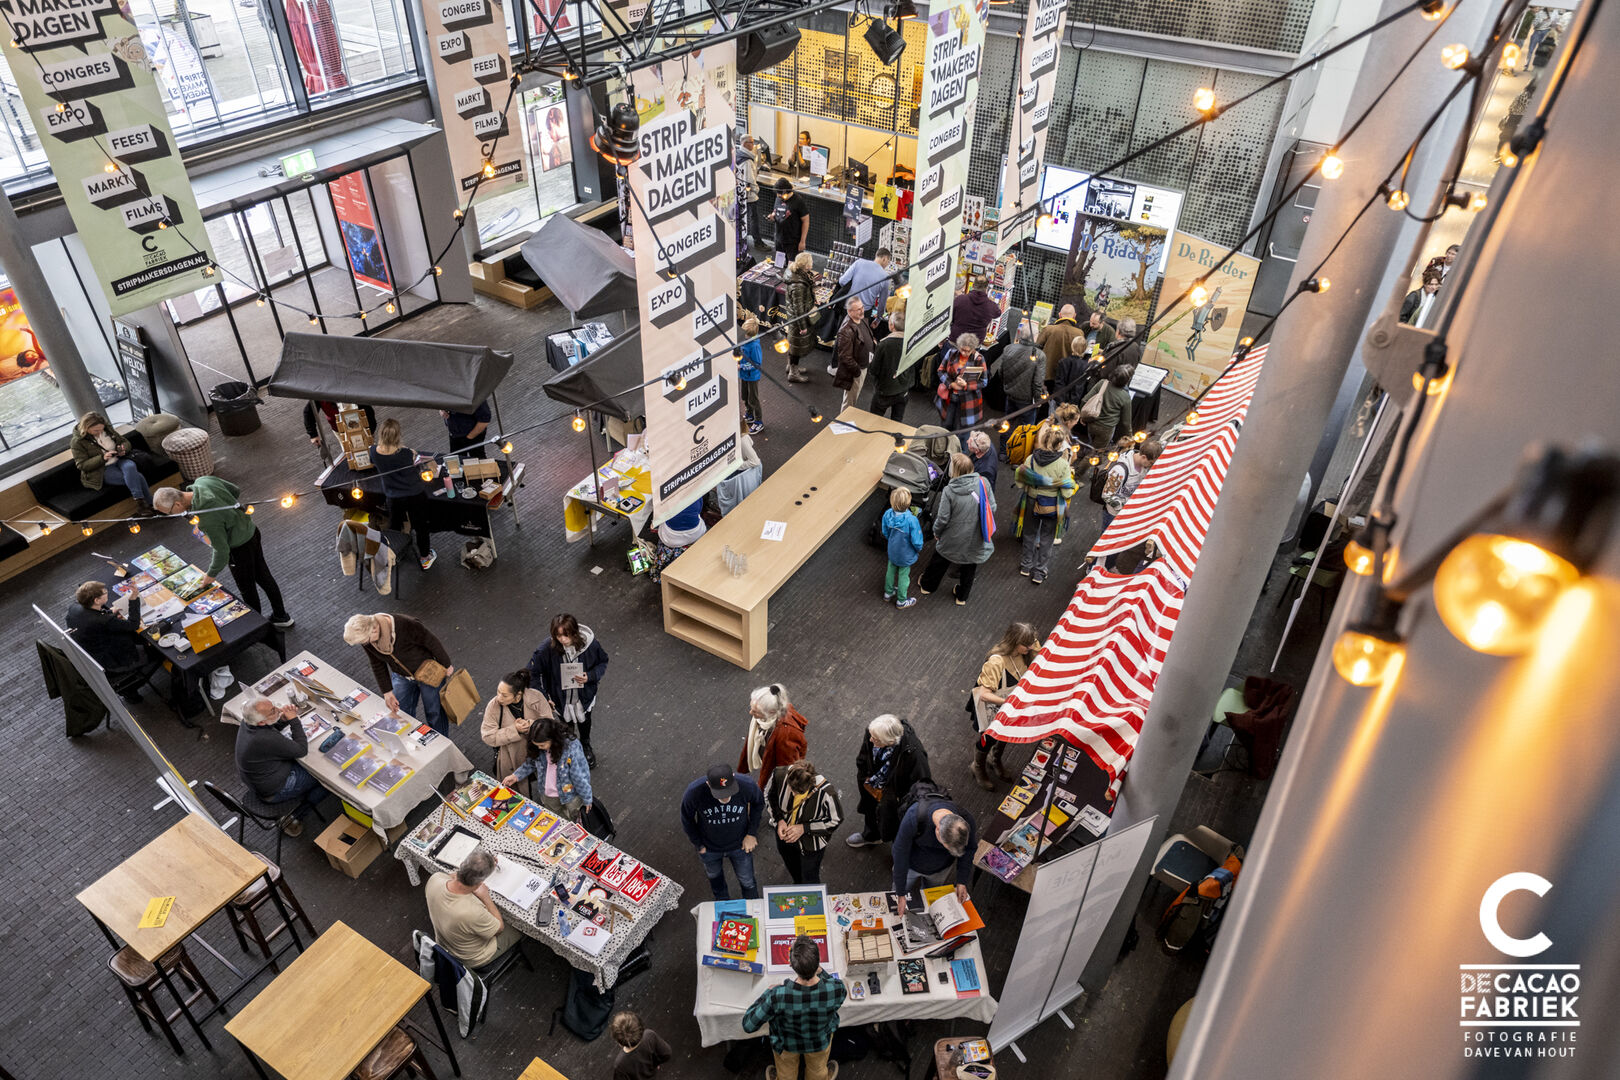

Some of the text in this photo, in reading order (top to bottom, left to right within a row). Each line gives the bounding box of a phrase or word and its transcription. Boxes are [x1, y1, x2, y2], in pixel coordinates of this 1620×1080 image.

[441, 2, 481, 18] CONGRES
[629, 8, 646, 18] FEEST
[1035, 8, 1058, 31] DAGEN
[13, 11, 91, 40] DAGEN
[440, 37, 462, 51] EXPO
[932, 36, 959, 65] STRIP
[42, 61, 111, 86] CONGRES
[473, 58, 498, 72] FEEST
[936, 50, 976, 84] MAKERS
[457, 92, 482, 108] MARKT
[930, 76, 964, 109] DAGEN
[47, 107, 86, 127] EXPO
[474, 116, 498, 130] FILMS
[111, 131, 150, 151] FEEST
[641, 119, 687, 157] STRIP
[929, 124, 961, 150] CONGRES
[656, 133, 723, 181] MAKERS
[88, 174, 131, 196] MARKT
[648, 166, 706, 211] DAGEN
[921, 171, 938, 192] EXPO
[125, 201, 164, 221] FILMS
[939, 191, 959, 212] FEEST
[657, 224, 712, 261] CONGRES
[919, 234, 939, 252] MARKT
[1080, 231, 1153, 264] De Ridder
[926, 260, 946, 281] FILMS
[1177, 242, 1248, 281] De Ridder
[117, 255, 206, 291] STRIPMAKERSDAGEN.NL
[651, 285, 682, 311] EXPO
[695, 303, 724, 330] FEEST
[688, 384, 717, 411] FILMS
[663, 439, 735, 494] STRIPMAKERSDAGEN.NL
[707, 804, 744, 816] PATRON
[584, 852, 608, 873] SARI
[605, 863, 628, 884] SARI
[624, 877, 648, 899] SARI
